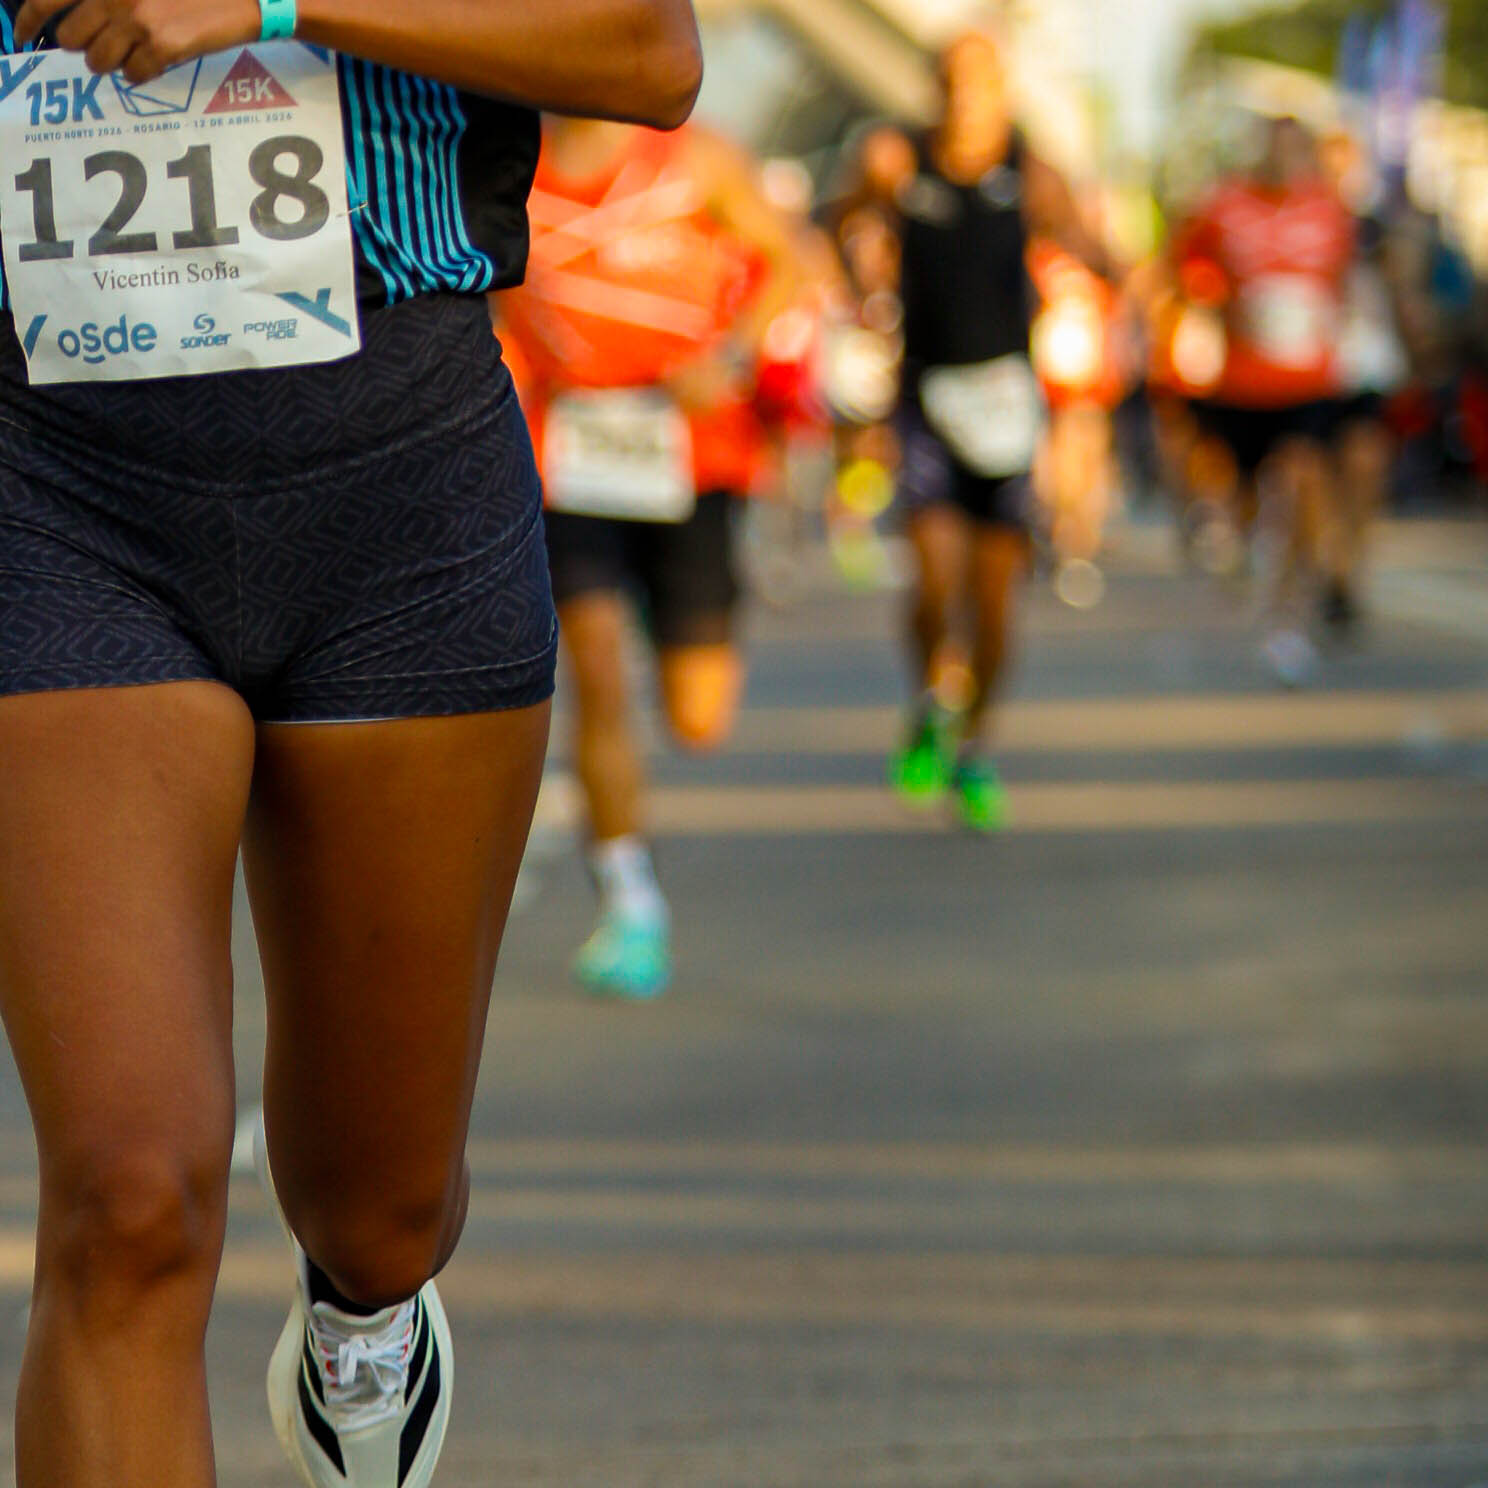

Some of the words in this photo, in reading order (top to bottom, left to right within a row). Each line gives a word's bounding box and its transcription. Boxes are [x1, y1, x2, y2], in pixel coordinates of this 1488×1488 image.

[25, 72, 105, 127] 15K
[223, 76, 275, 105] 15K
[24, 131, 61, 143] PUERTO
[64, 128, 94, 139] NORTE
[133, 121, 181, 134] ROSARIO
[210, 117, 223, 127] DE
[228, 115, 260, 125] ABRIL
[14, 135, 331, 262] 1218
[93, 265, 180, 291] Vicentin
[243, 318, 299, 334] POWER
